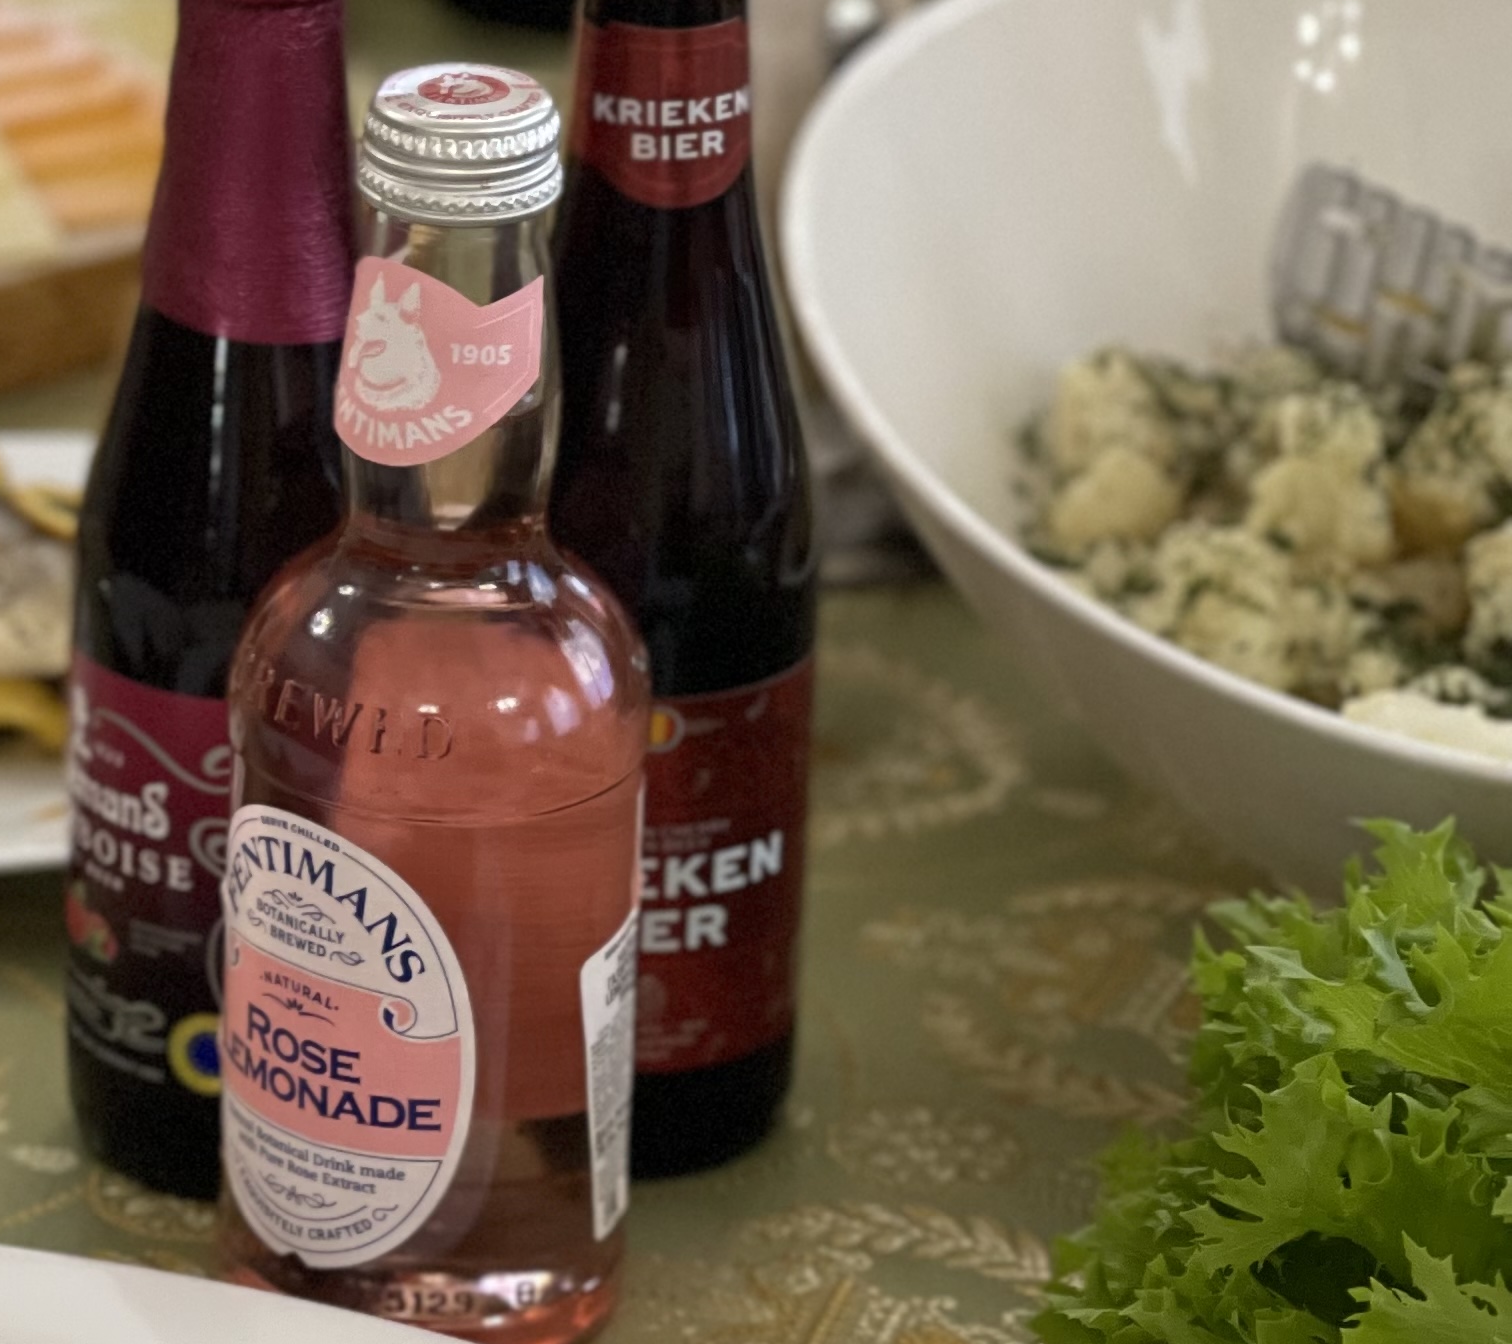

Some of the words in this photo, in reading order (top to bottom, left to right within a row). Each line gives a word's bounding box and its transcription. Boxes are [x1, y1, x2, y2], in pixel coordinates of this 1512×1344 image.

[593, 85, 750, 128] KRIEKEN
[630, 129, 725, 162] BIER
[450, 343, 514, 366] 1905
[338, 392, 473, 450] NTIMANS
[290, 823, 341, 854] CHILLED
[639, 829, 784, 901] EKEN
[228, 835, 426, 984] FENTIMANS
[256, 897, 345, 944] BOTANICALLY
[639, 904, 728, 954] ER
[269, 924, 327, 958] BREWED
[247, 1001, 362, 1085] ROSE
[287, 1158, 319, 1182] Rose
[322, 1173, 377, 1195] Extract
[313, 1152, 356, 1175] Drink
[360, 1163, 406, 1182] made
[307, 1217, 373, 1241] CRAFTED
